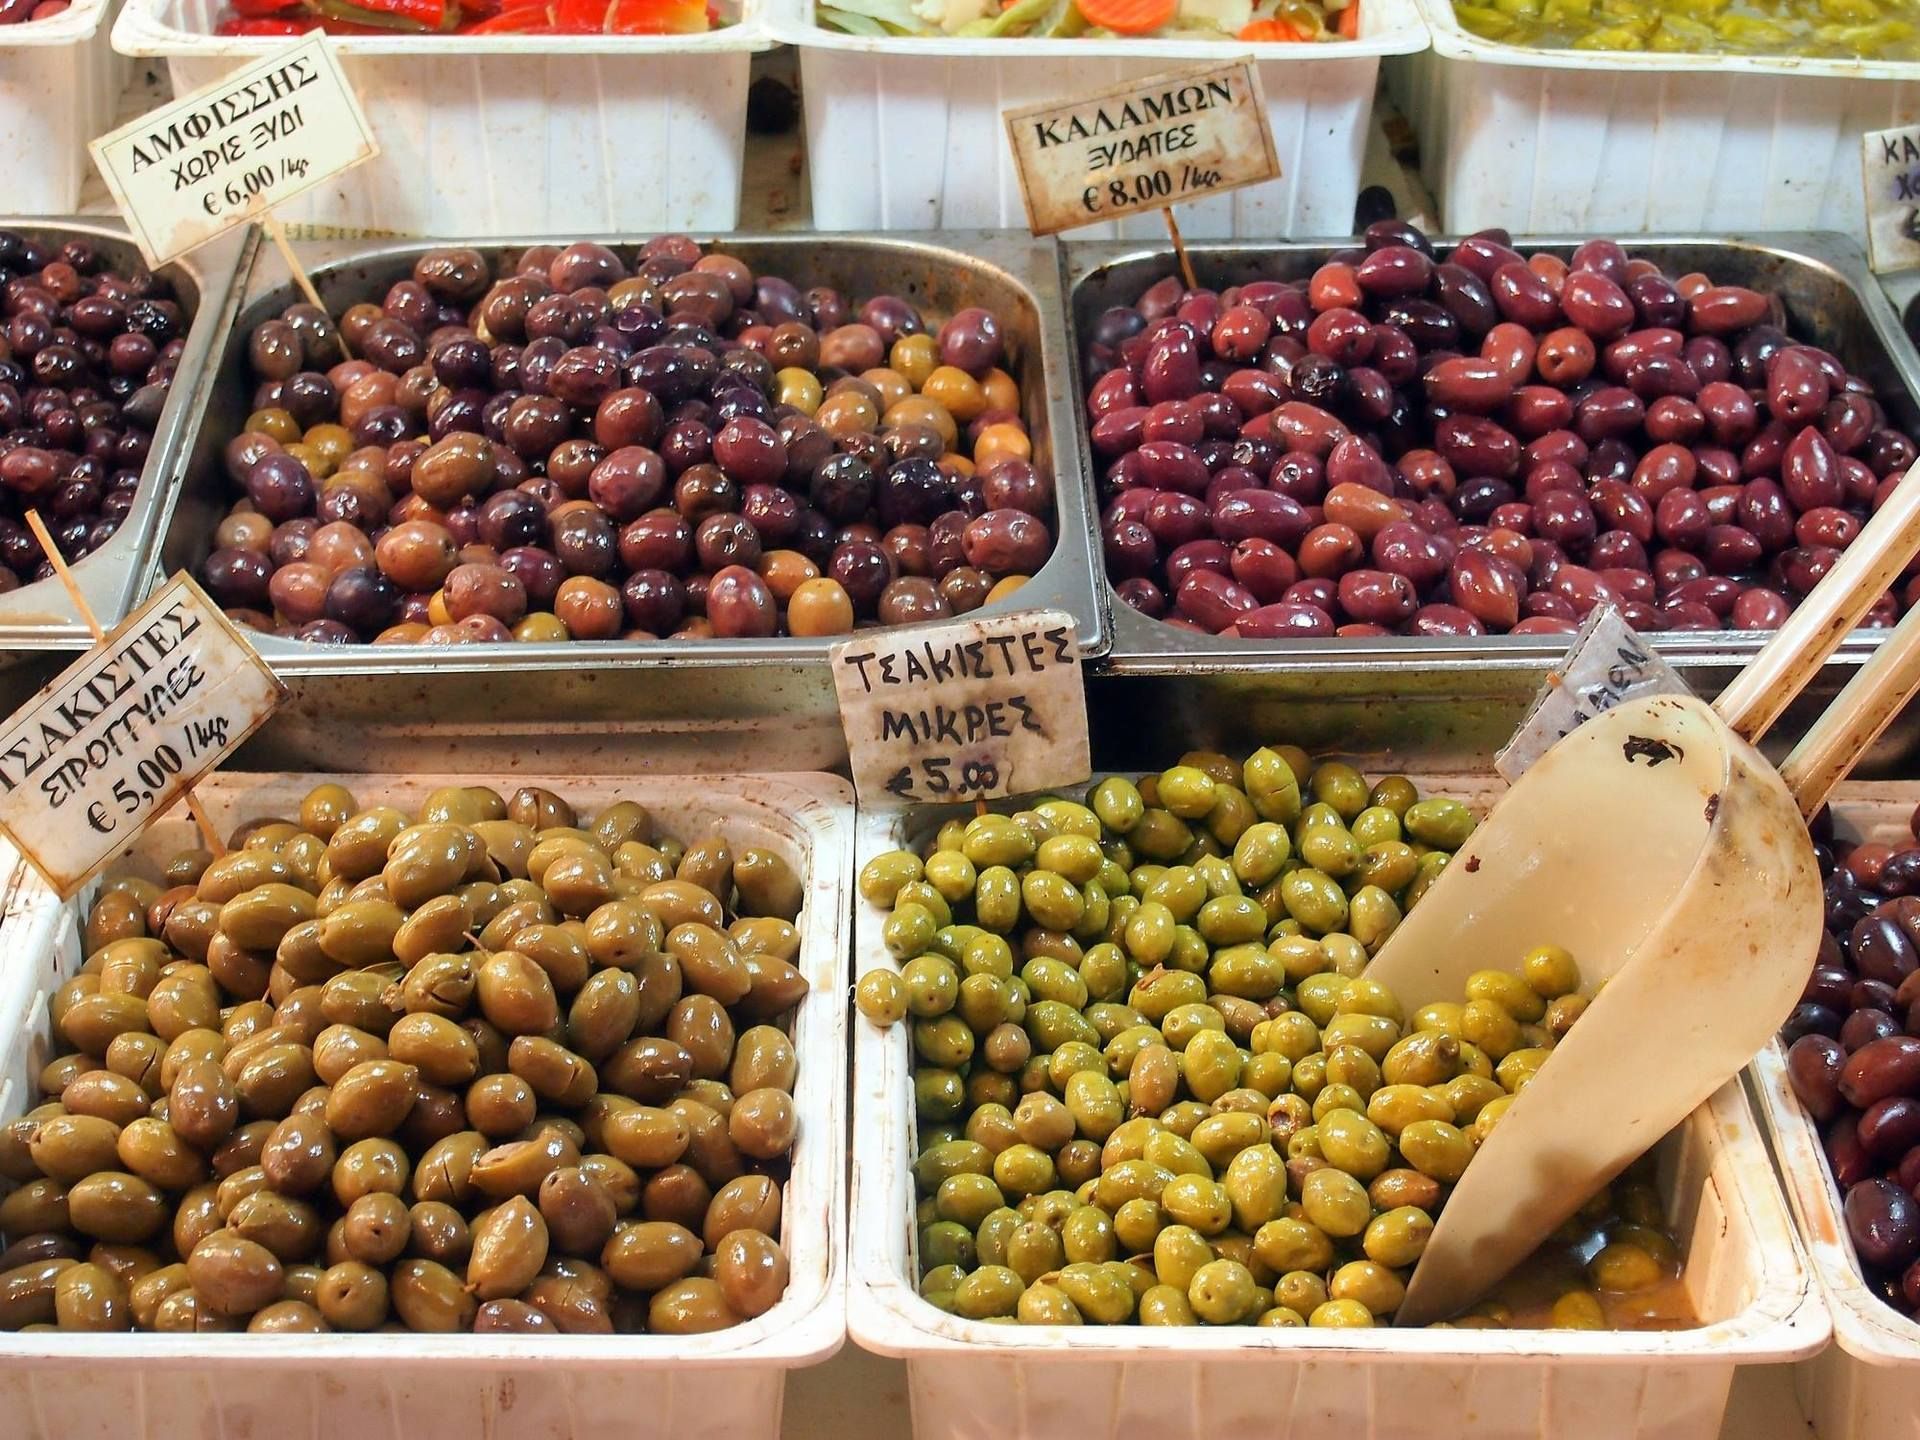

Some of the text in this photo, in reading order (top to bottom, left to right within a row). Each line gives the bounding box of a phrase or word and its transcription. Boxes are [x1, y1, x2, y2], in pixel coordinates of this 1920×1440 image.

[132, 56, 319, 174] ΑΜΦΙΣΣΗΣ
[1034, 78, 1232, 149] ΚΑΛΑΜΩΝ
[1088, 124, 1198, 171] ΞΥΔΑΤΕΣ
[844, 626, 1074, 693] ΤΣΑΚΙΣΤΕΣ
[882, 695, 1042, 746] ΜΙΚΡΕΣ
